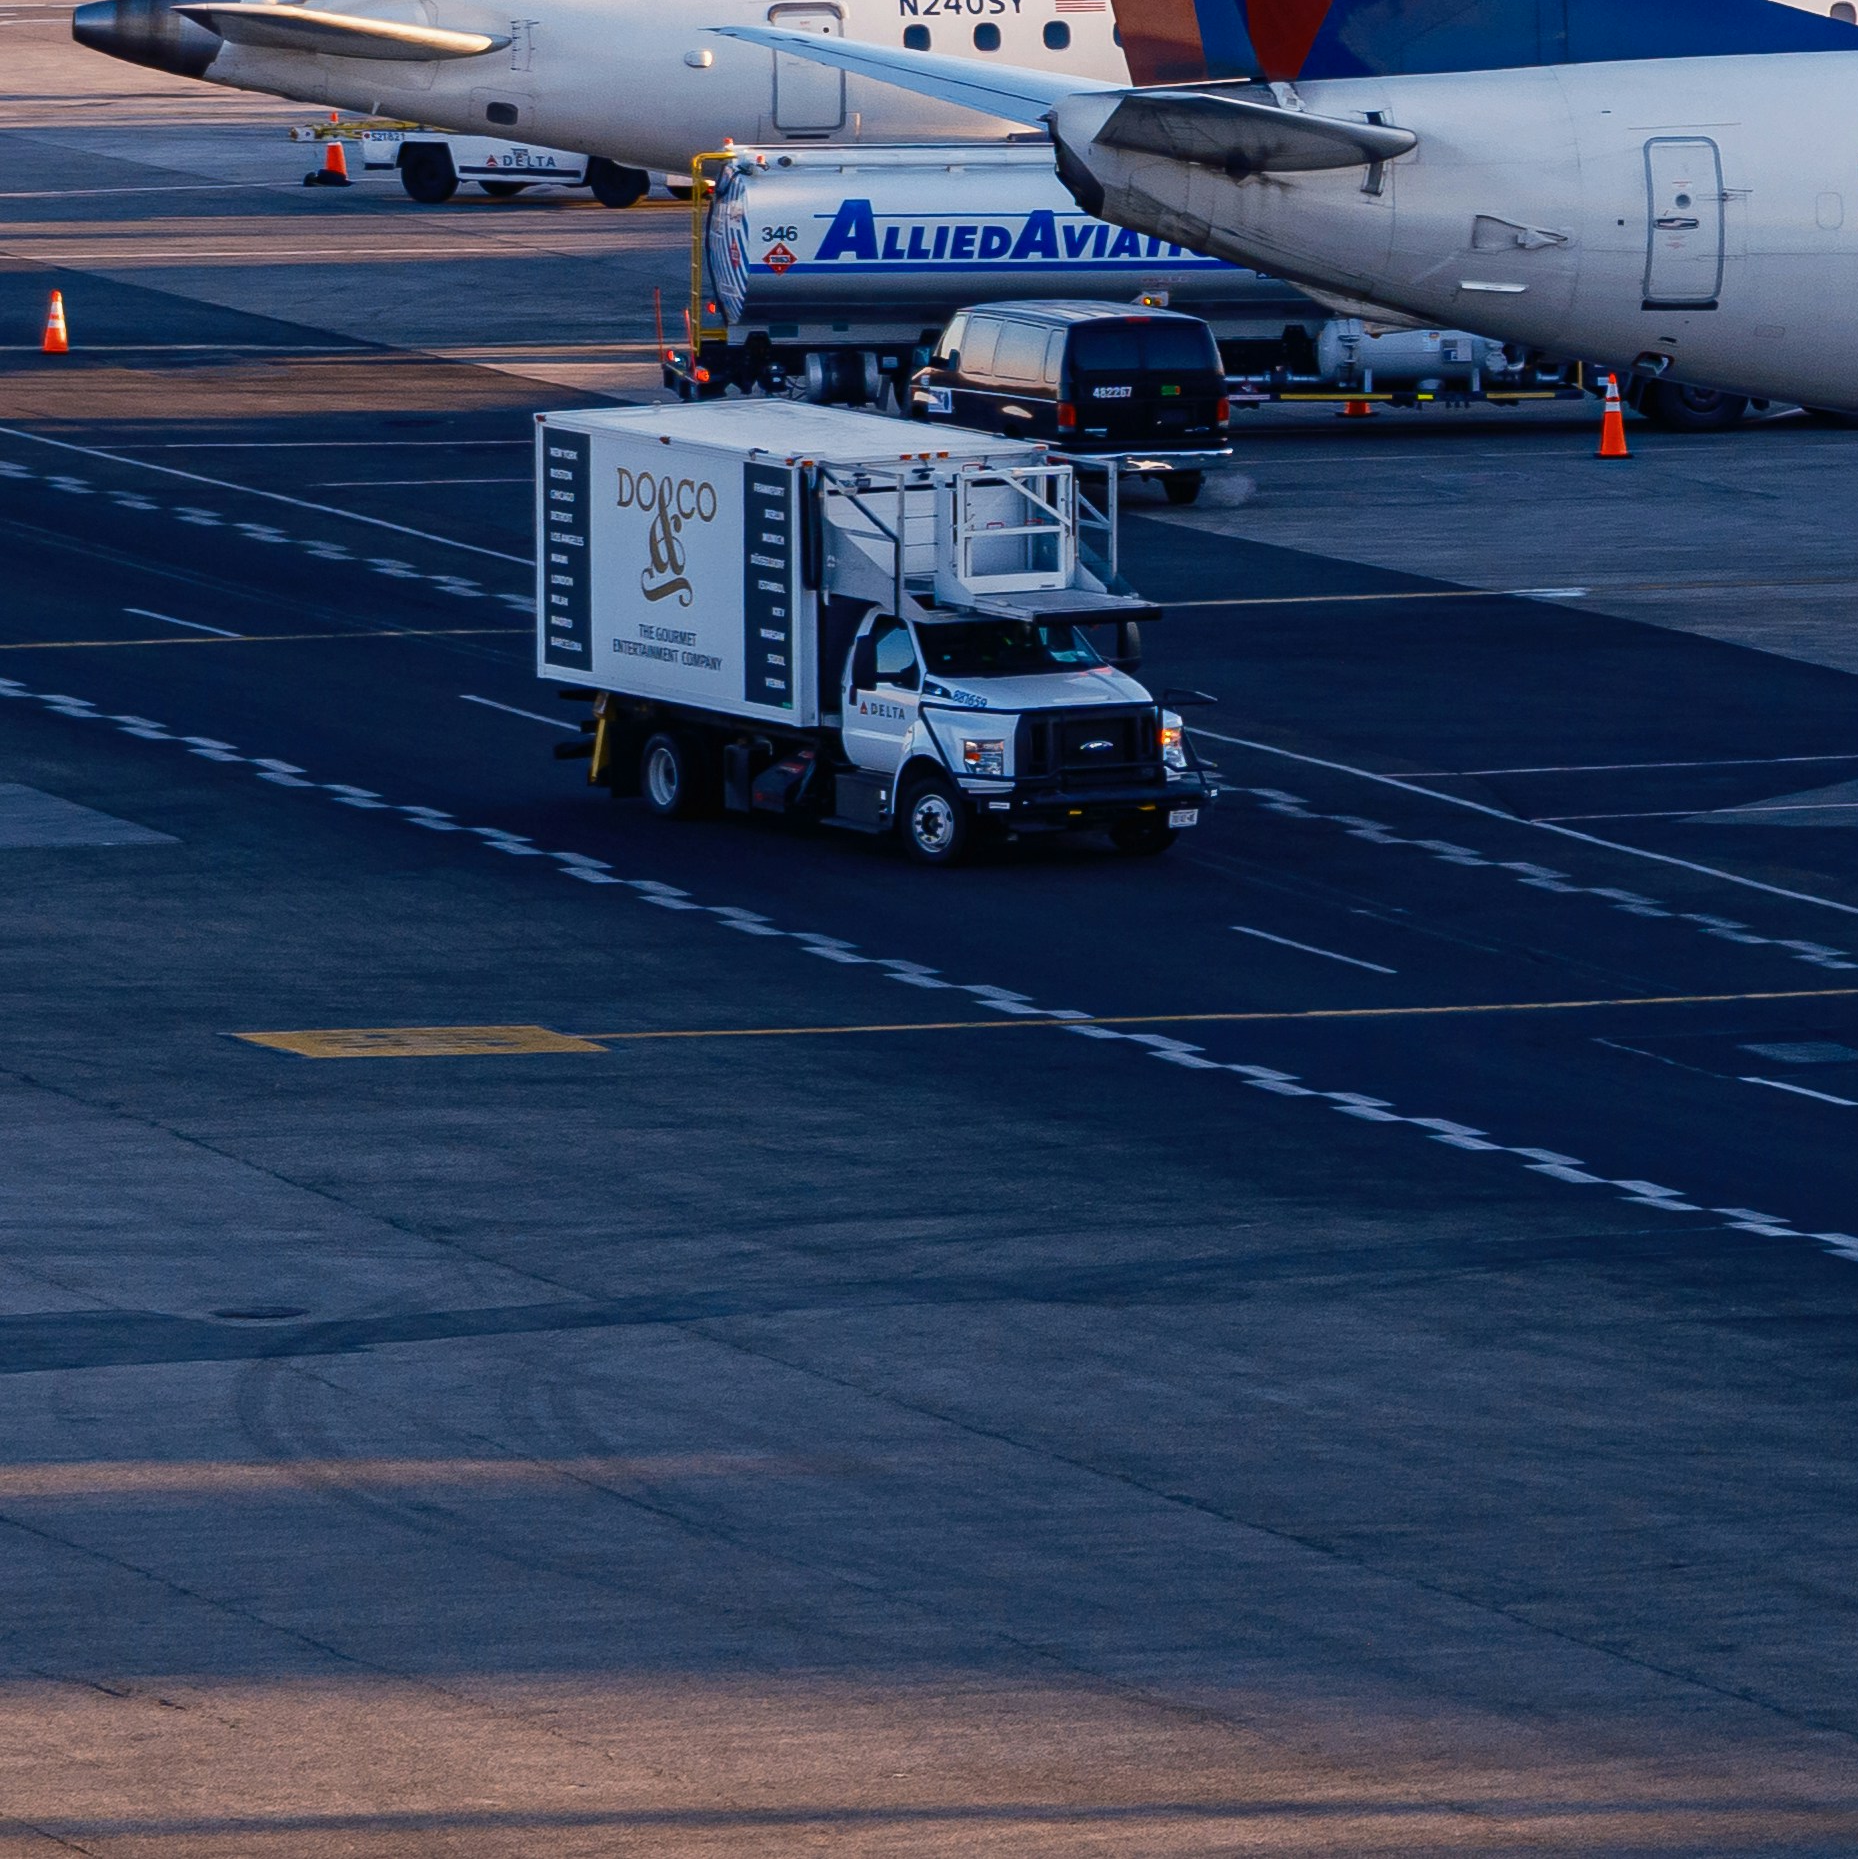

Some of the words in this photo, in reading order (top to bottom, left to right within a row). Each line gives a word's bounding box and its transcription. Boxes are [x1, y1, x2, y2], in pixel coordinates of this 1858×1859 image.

[503, 155, 557, 168] DELTA
[762, 225, 799, 243] 346
[638, 623, 655, 639] THE
[655, 626, 697, 647] GOURMET
[613, 638, 680, 665] ENTERTAINMENT
[681, 650, 723, 671] COMPANY
[871, 704, 906, 720] DELTA
